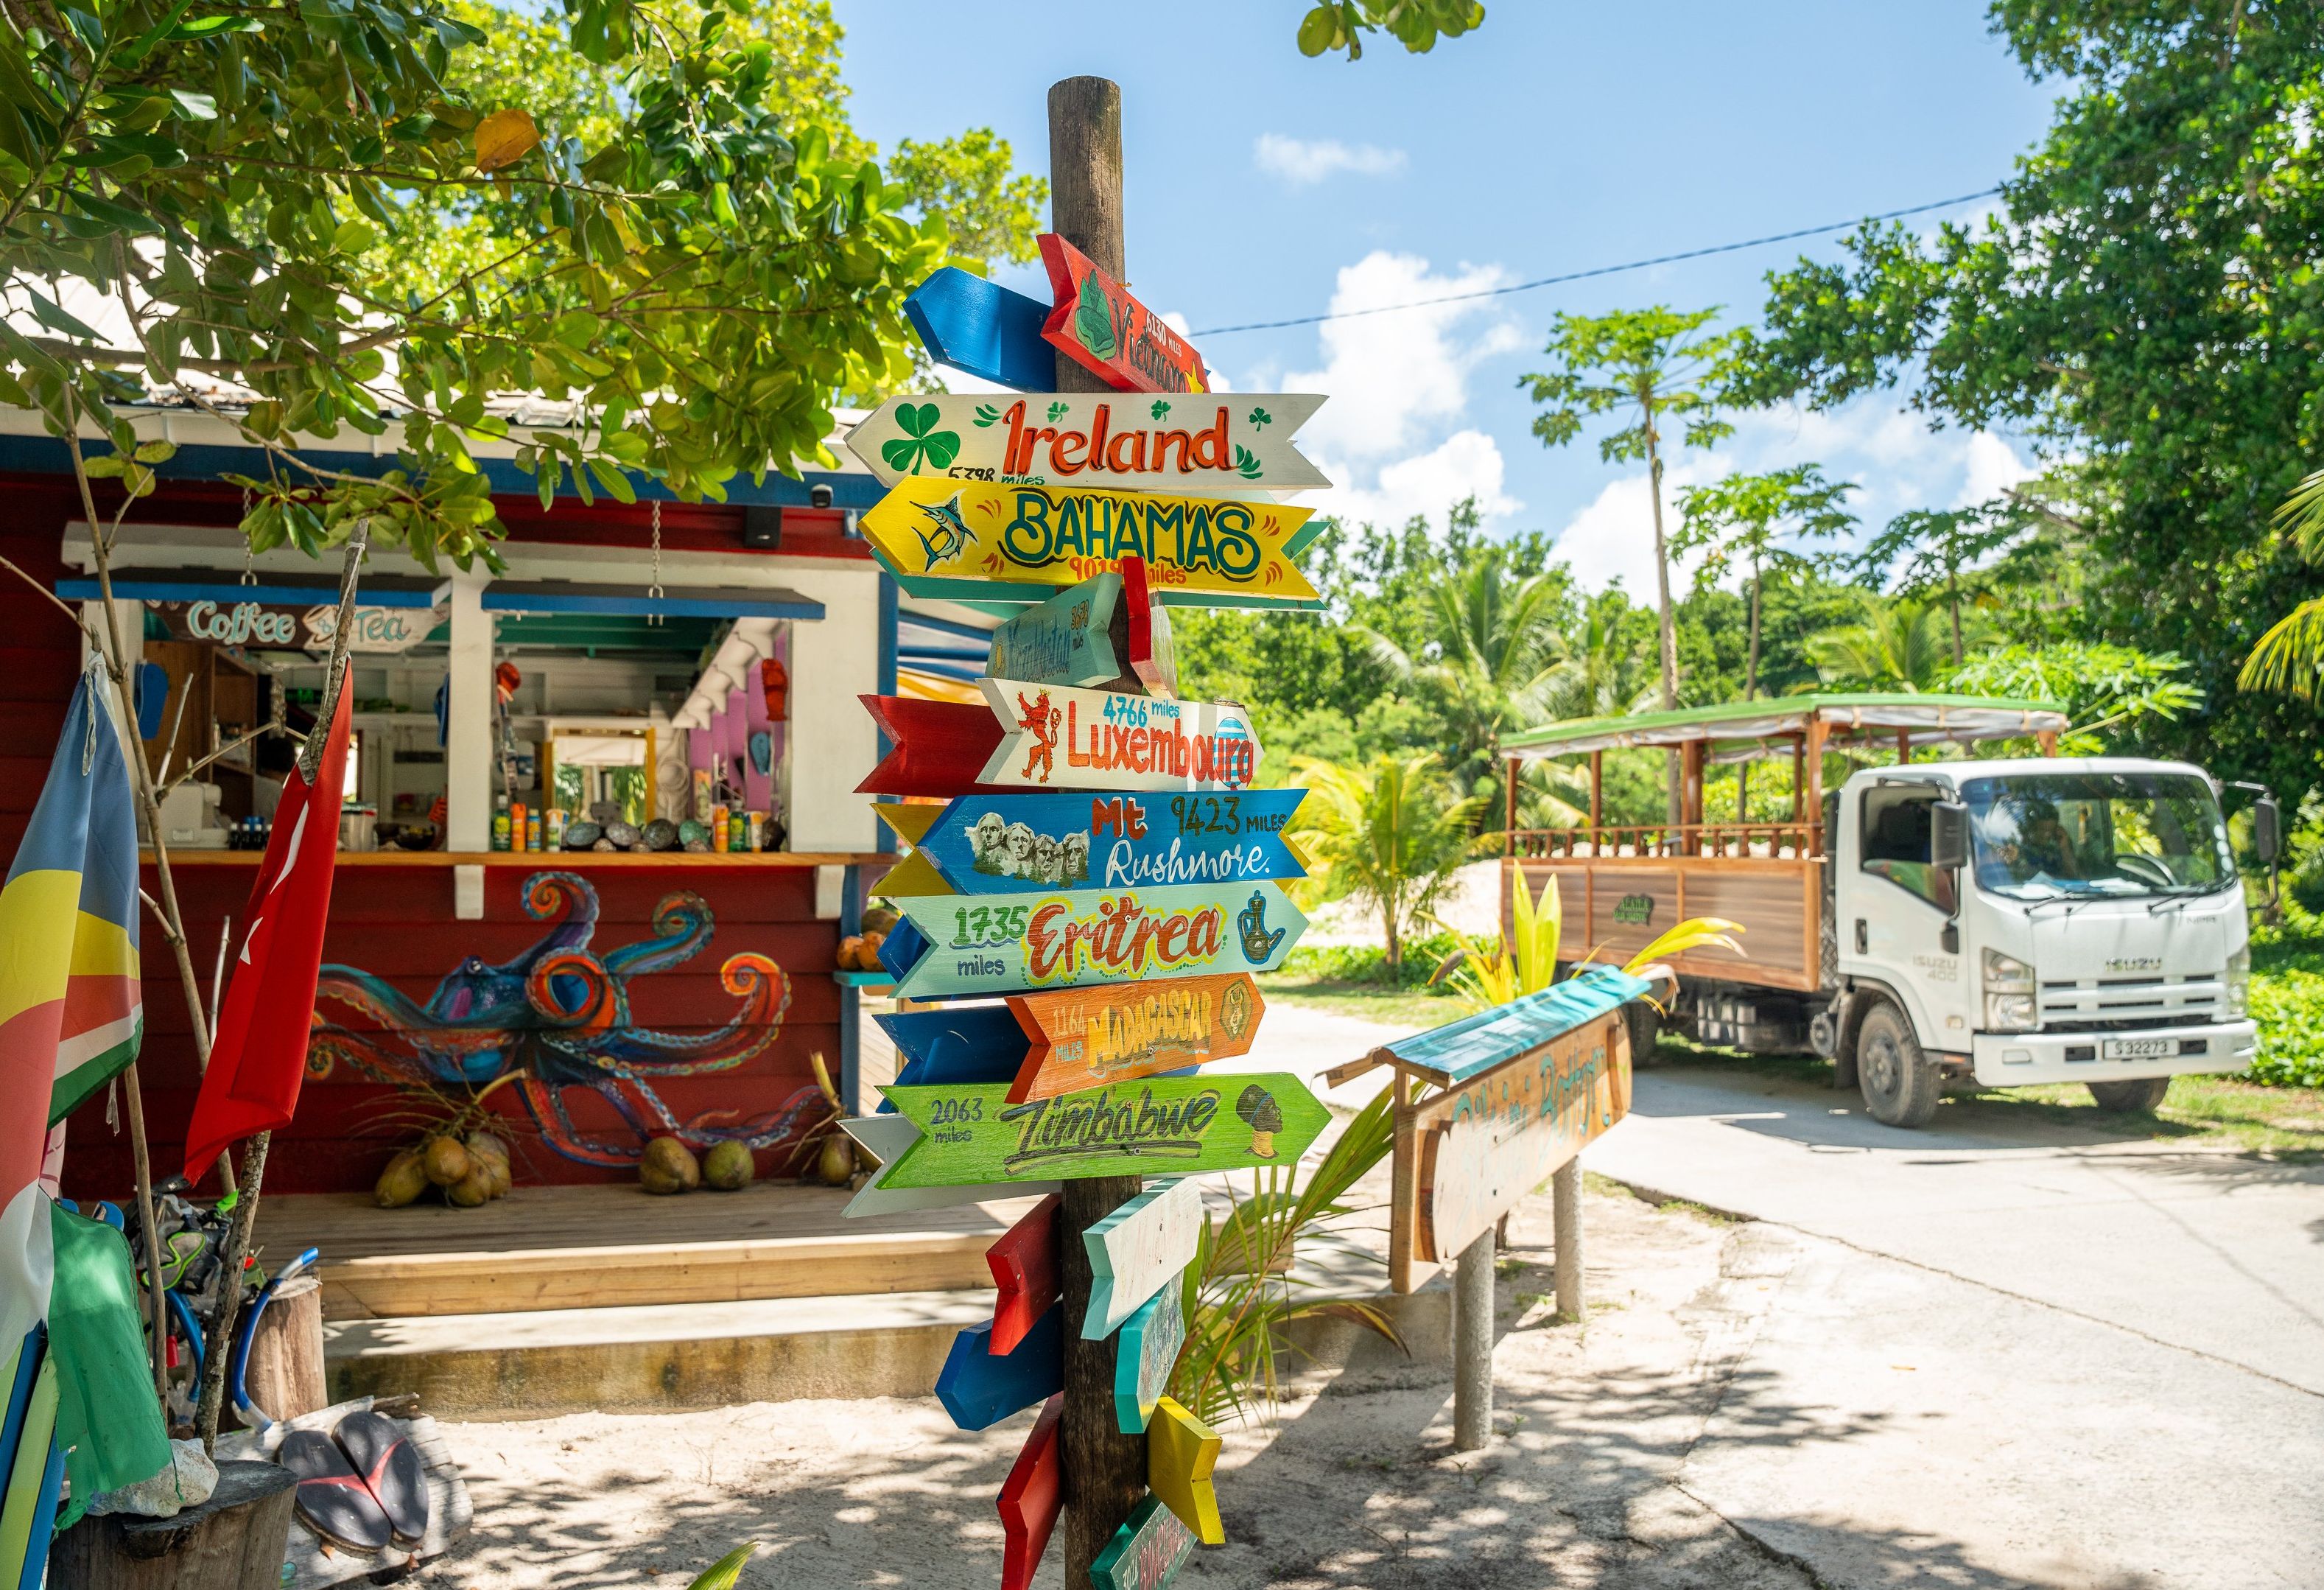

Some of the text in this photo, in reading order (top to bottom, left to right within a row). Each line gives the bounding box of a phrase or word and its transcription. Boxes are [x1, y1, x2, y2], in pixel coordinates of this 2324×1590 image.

[1112, 298, 1186, 393] Vietnam
[1146, 311, 1183, 358] 6130 MILES
[1003, 399, 1239, 476] Ireland
[1001, 474, 1045, 486] miles
[1003, 492, 1262, 575] BAHAMAS
[186, 600, 297, 645] Coffee
[355, 609, 412, 643] Tea
[1103, 695, 1180, 728] 4766 miles
[1092, 796, 1148, 841] Mt
[1171, 796, 1287, 838] 9423 MILES
[953, 906, 1030, 946] 1735
[1027, 897, 1222, 978] Eritrea
[958, 956, 1005, 977] miles
[1912, 954, 1957, 970] ISUZU
[2104, 958, 2162, 972] ISUZU
[1053, 1005, 1086, 1037] 1164
[1088, 988, 1212, 1069] MADAGASCAR
[1056, 1040, 1084, 1063] MILES
[930, 1097, 983, 1125] 2063
[997, 1085, 1221, 1152] Zimbabwe
[934, 1130, 973, 1144] miles
